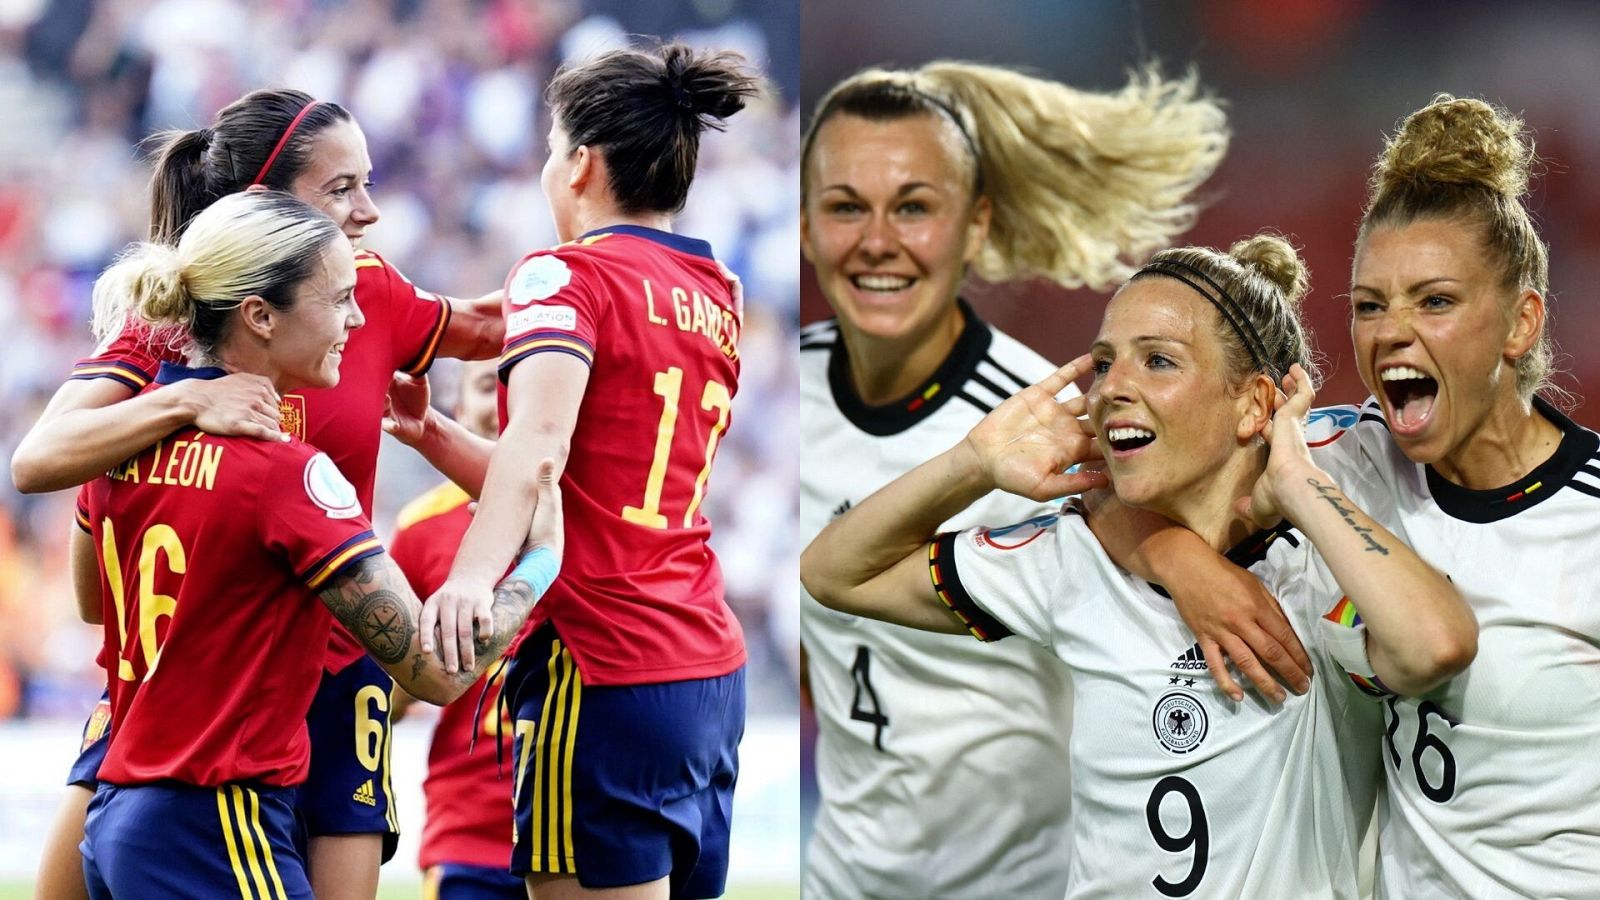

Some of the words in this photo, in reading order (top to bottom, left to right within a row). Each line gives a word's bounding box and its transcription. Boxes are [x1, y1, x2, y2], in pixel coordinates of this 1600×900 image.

[643, 279, 668, 326] L.
[147, 431, 224, 491] LEÓN
[621, 366, 731, 529] 17
[102, 516, 187, 683] 16
[850, 645, 889, 752] 4
[1170, 660, 1208, 670] adidas
[355, 685, 388, 772] 6
[1163, 700, 1196, 713] DEUTSCHER
[353, 793, 376, 807] adidas
[1146, 776, 1209, 898] 9
